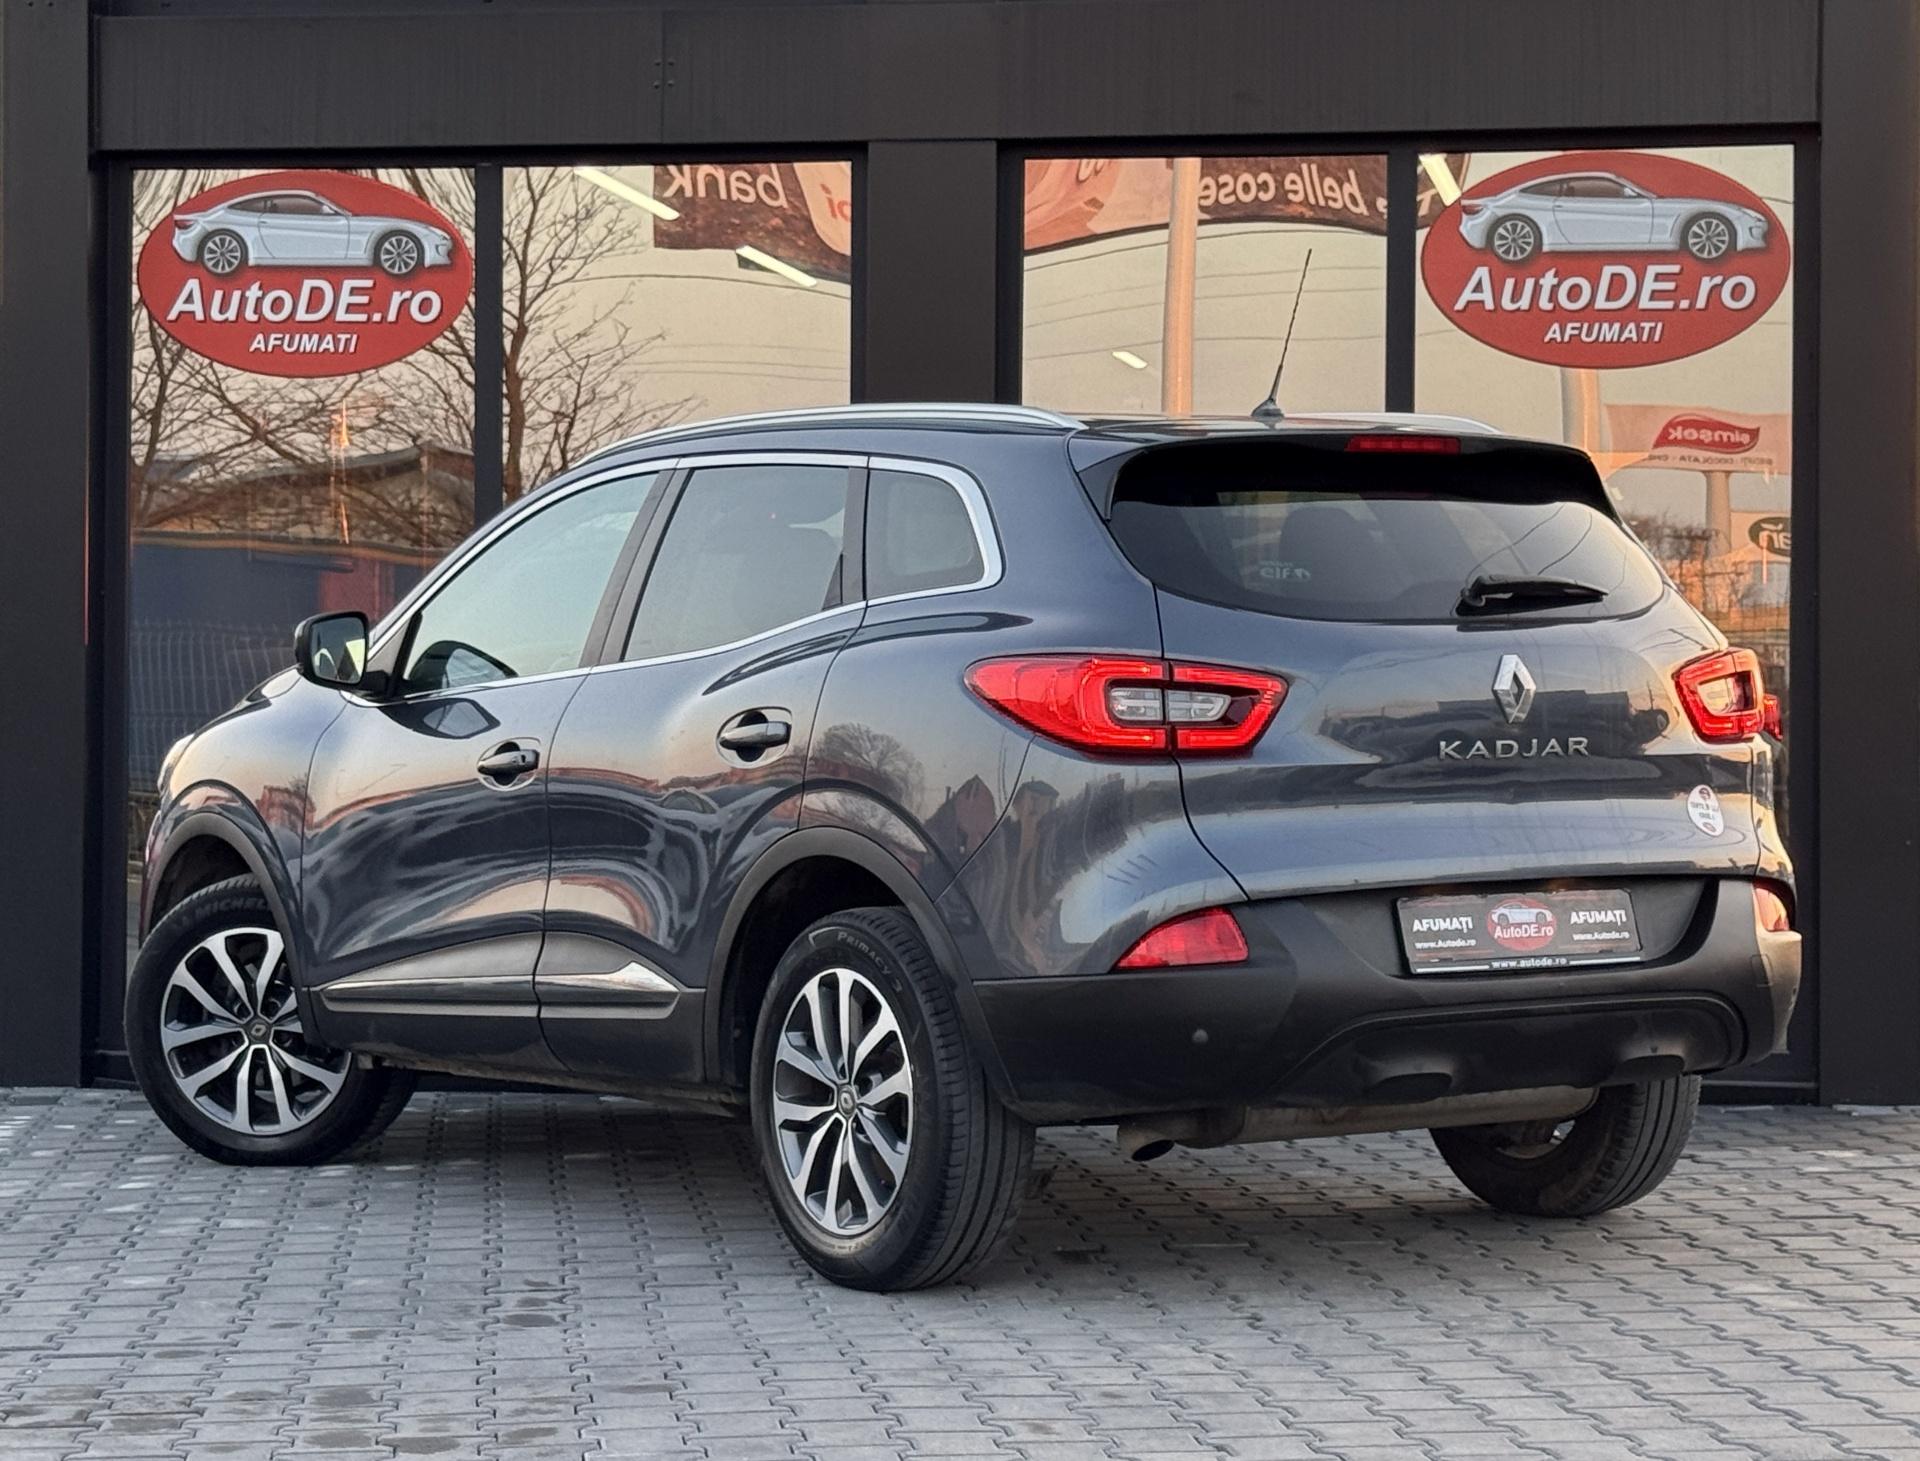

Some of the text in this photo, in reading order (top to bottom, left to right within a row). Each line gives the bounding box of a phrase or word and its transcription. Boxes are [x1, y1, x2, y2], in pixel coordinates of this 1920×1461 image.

[1453, 264, 1757, 312] AutoDE.ro
[166, 277, 443, 323] AutoDE.ro
[248, 333, 359, 354] AFUMATI
[1543, 322, 1664, 344] AFUMATI
[1439, 737, 1590, 760] KADJAR
[1494, 924, 1554, 939] AutoDE.ro
